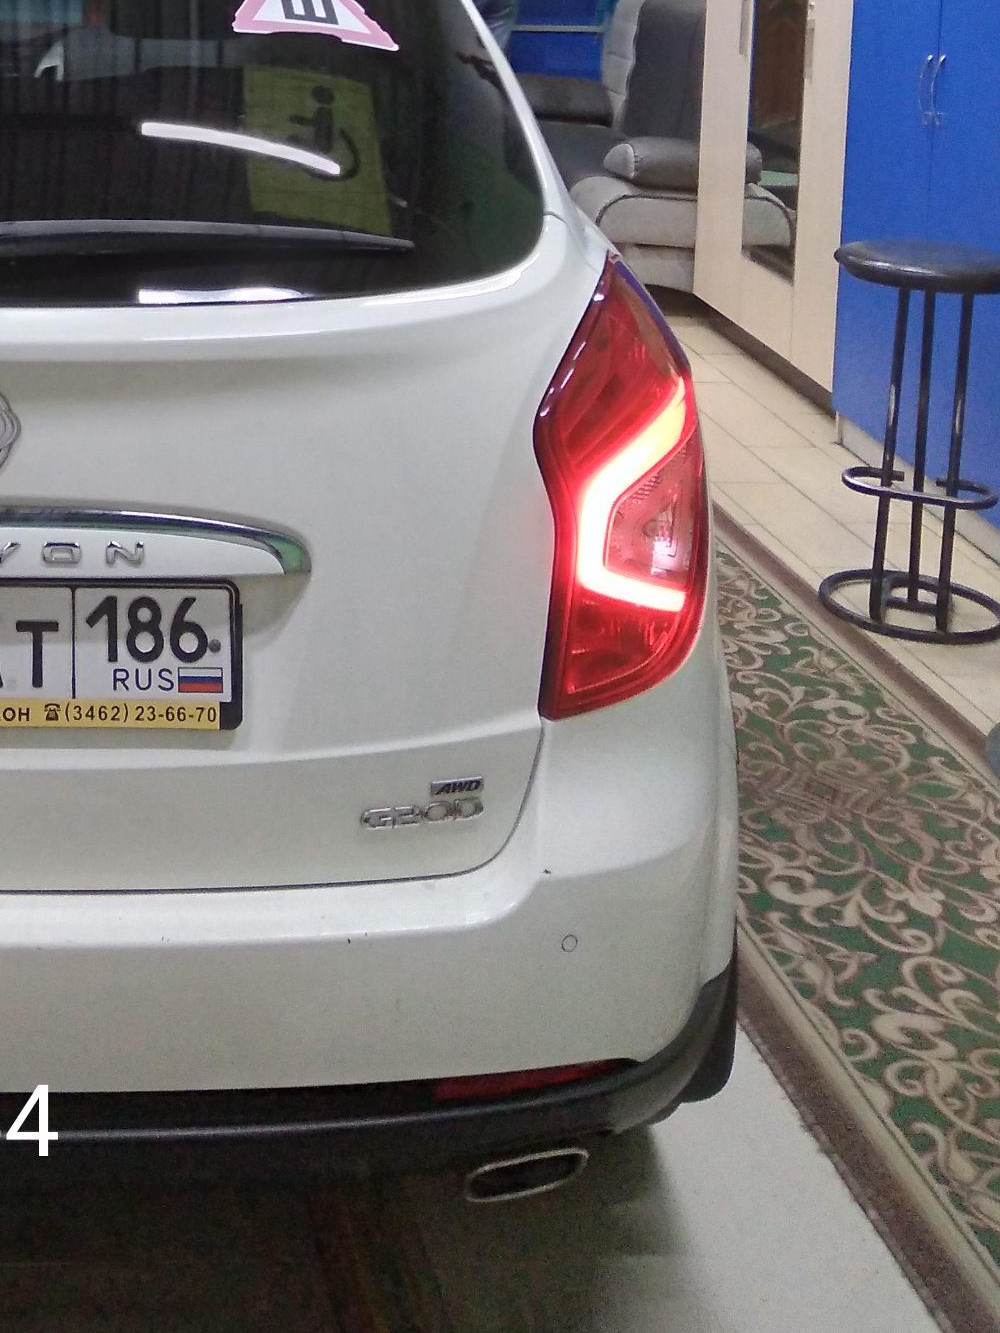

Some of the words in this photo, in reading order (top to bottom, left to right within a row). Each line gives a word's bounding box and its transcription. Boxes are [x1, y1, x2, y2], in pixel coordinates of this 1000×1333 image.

[85, 596, 210, 664] 186
[113, 668, 175, 691] RUS
[65, 702, 129, 722] (3462)
[135, 705, 217, 722] 23-66-70
